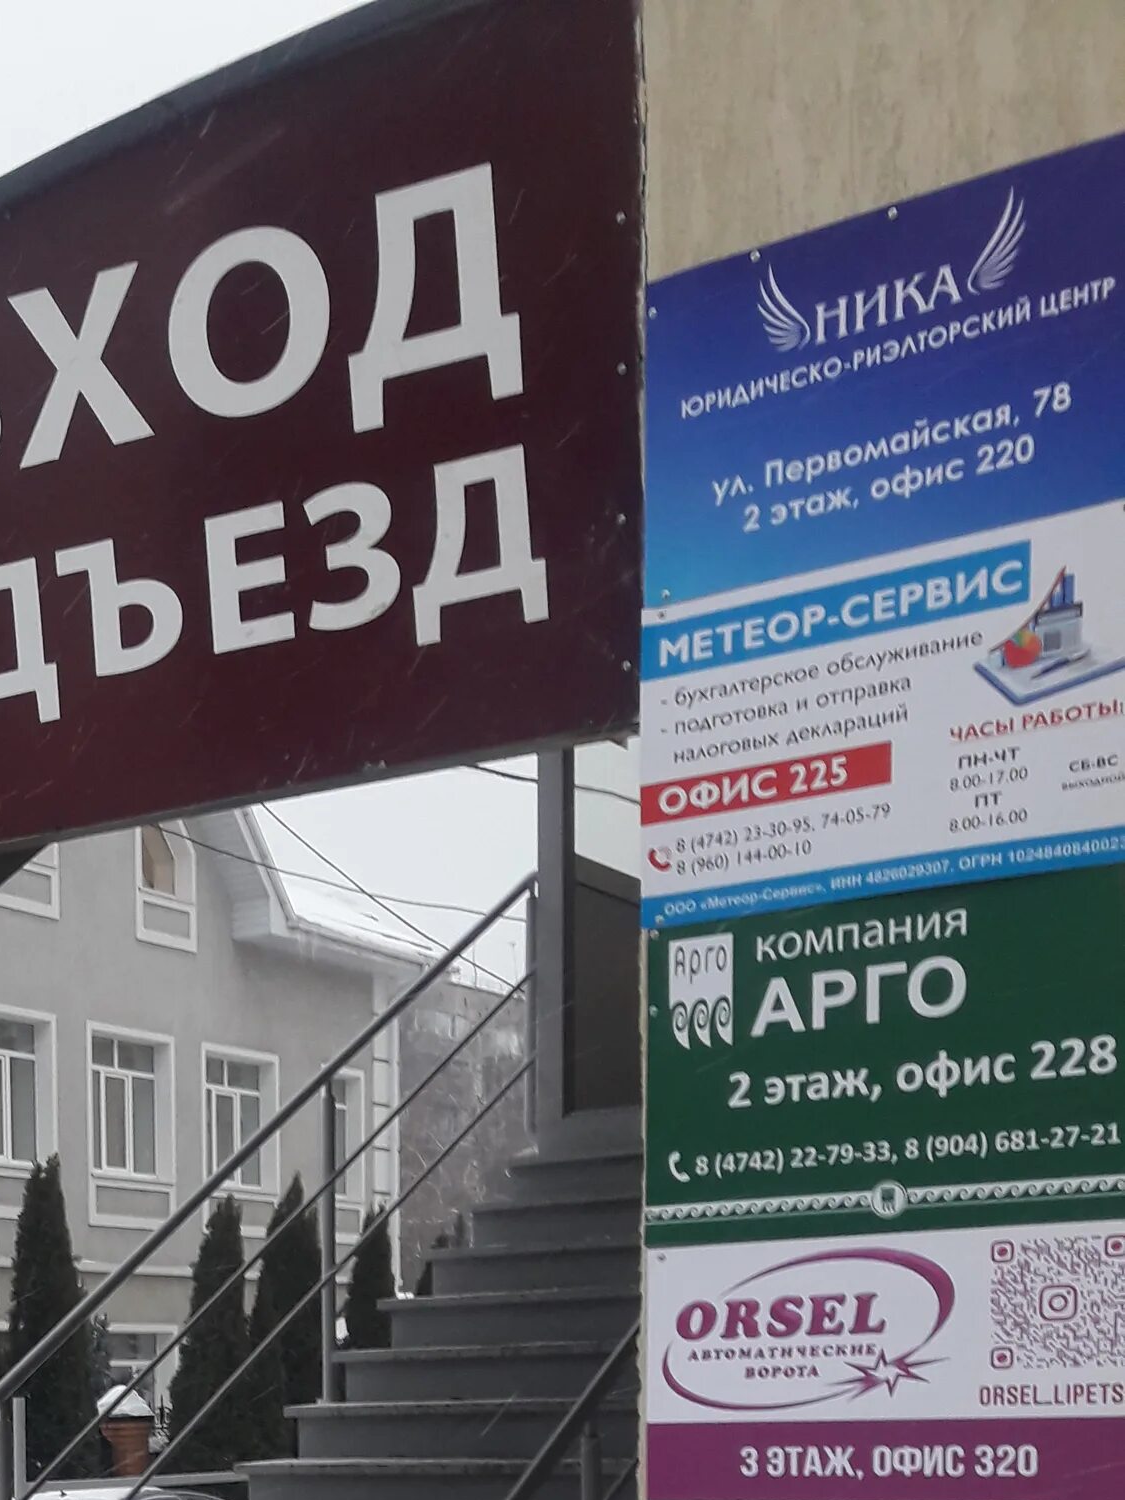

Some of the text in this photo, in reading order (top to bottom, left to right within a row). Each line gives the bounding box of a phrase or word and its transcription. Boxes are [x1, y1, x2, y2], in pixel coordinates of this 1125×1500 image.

[815, 264, 963, 346] НИКА
[681, 277, 1116, 419] ЮРИДИЧЕСКО-РИЭЛТОРСКИЙ ЦЕНТР
[713, 382, 1072, 507] ул. Первомайская, 78
[743, 434, 1036, 533] 2 этаж, офис 220
[659, 560, 1024, 668] МЕТЕОР-СЕРВИС
[675, 663, 818, 709] бухгалтерское
[826, 630, 983, 677] обслуживание
[674, 701, 788, 735] подготовка
[796, 697, 809, 711] и
[816, 676, 912, 709] отправка
[674, 702, 910, 764] налоговых деклараций
[949, 717, 1015, 742] ЧАСЫ
[658, 755, 849, 816] ОФИС 225
[949, 767, 1028, 792] 8.00-17.00
[958, 746, 1020, 770] ПН-ЧТ
[949, 808, 1028, 833] 8.00-16.00
[974, 791, 1003, 808] ПТ
[676, 839, 813, 877] 8 (960) 144-00-10
[691, 829, 738, 857] (4742)
[821, 803, 891, 830] 74-05-79
[664, 901, 697, 916] ООО
[830, 872, 862, 891] ИНН
[959, 851, 1003, 872] ОГРН
[755, 908, 968, 963] компания
[750, 956, 968, 1038] АРГО
[727, 1034, 1118, 1108] 2 этаж, офис 228
[694, 1122, 1122, 1179] 8 (4742) 22-79-33, 8 (904) 681-27-21
[675, 1292, 887, 1342] ORSEL
[688, 1343, 877, 1362] АВТОМАТИЧЕСКИЕ
[744, 1364, 820, 1380] ВОРОТА
[739, 1444, 1039, 1481] 3 ЭТАЖ, ОФИС 320
